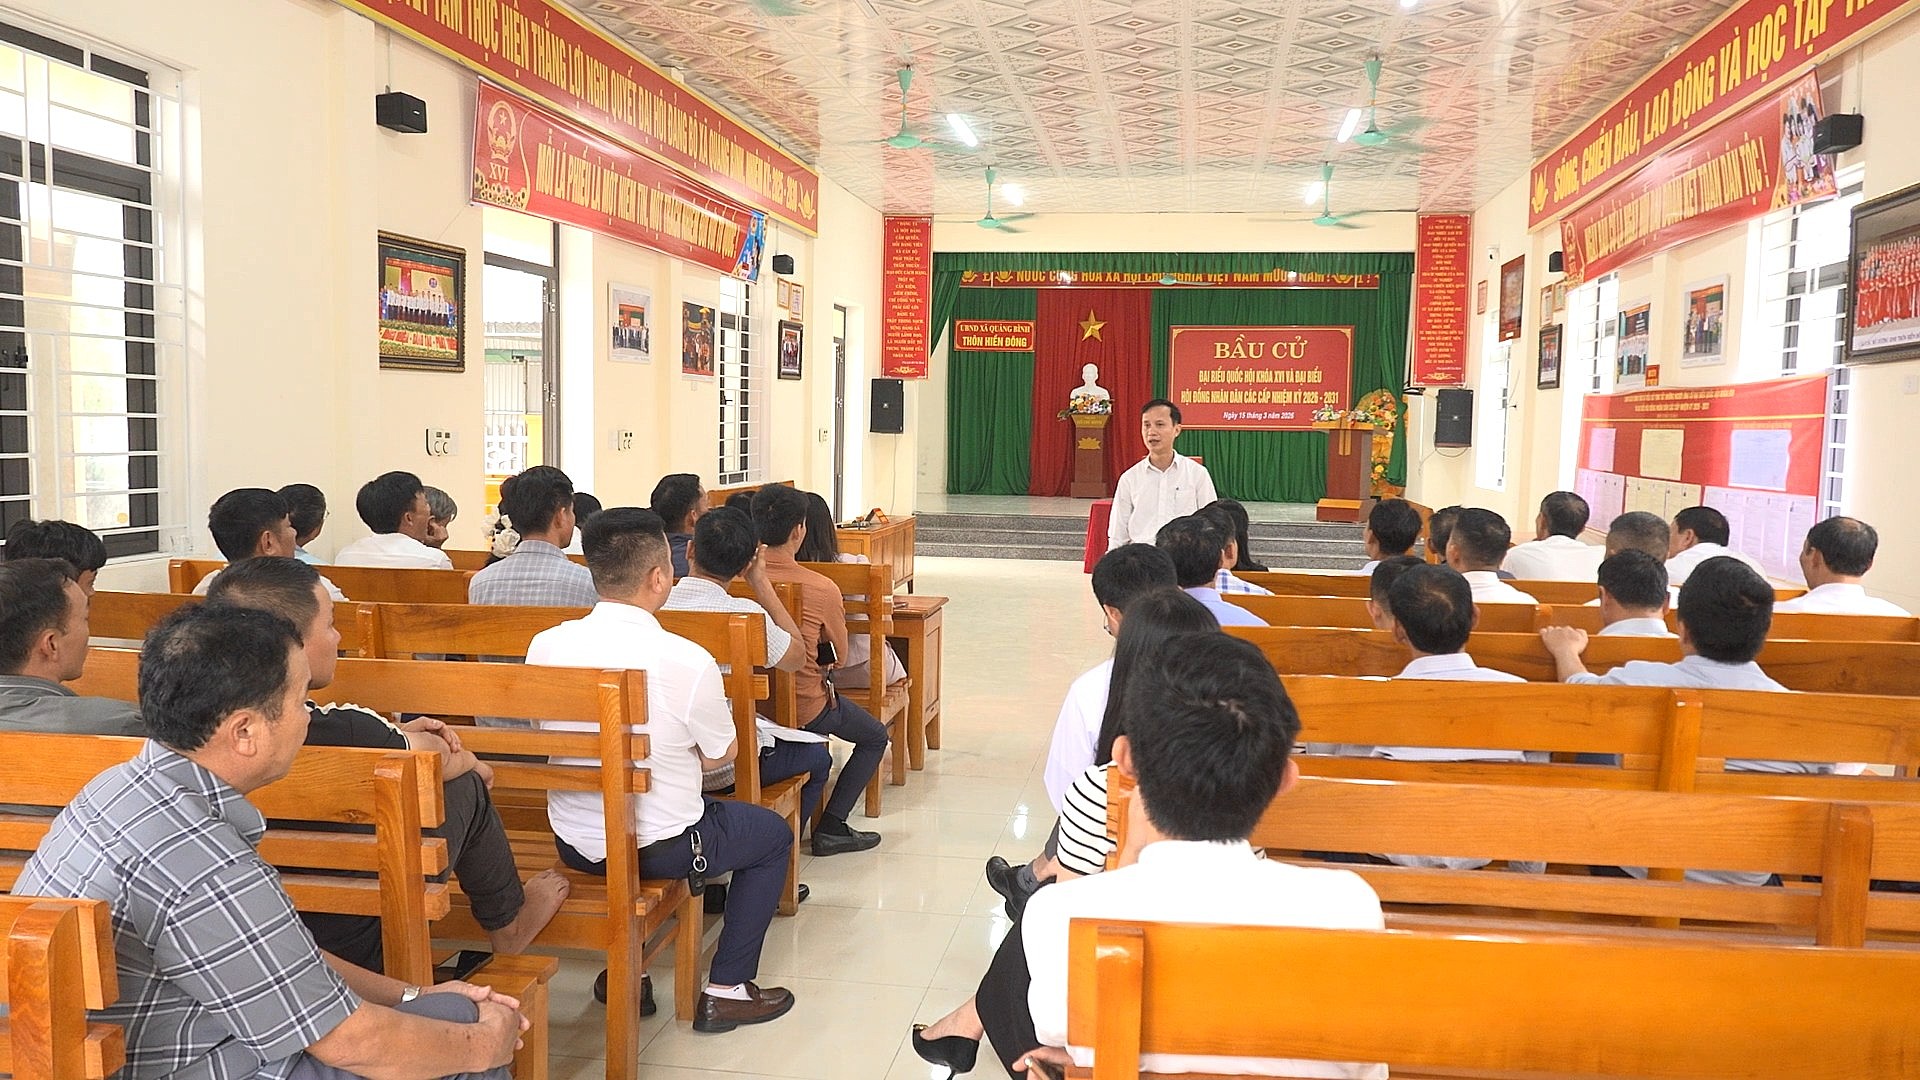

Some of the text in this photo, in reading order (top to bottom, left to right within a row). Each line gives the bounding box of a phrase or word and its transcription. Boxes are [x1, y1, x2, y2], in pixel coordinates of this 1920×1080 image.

[501, 1, 529, 78] HIỆN
[531, 10, 567, 91] THẮNG
[568, 44, 584, 109] LỢI
[586, 54, 609, 124] NGHỊ
[610, 65, 637, 127] QUYẾT
[653, 89, 666, 152] HỘI
[667, 92, 688, 154] ĐẢNG
[1581, 120, 1613, 186] CHIẾN
[1613, 100, 1640, 165] ĐẤU,
[1643, 88, 1670, 145] LAO
[1672, 61, 1715, 129] ĐỘNG
[1719, 26, 1741, 96] VÀ
[1745, 4, 1788, 82] HỌC
[489, 161, 509, 183] XVI
[554, 142, 567, 200] LÁ
[567, 145, 591, 208] PHIẾU
[591, 156, 601, 212] LÀ
[1720, 141, 1743, 204] DÂN
[1738, 131, 1762, 206] TỘC
[960, 324, 979, 332] UBND
[1013, 324, 1031, 333] BÌNH
[962, 334, 983, 347] THÔN
[1213, 333, 1308, 359] BẦU CỬ
[1199, 365, 1322, 385] ĐẠI BIỂU QUỐC HỘI KHÓA XVI VÀ ĐẠI BIỂU
[1181, 388, 1192, 406] HỘI
[1193, 386, 1210, 403] ĐỒNG
[1211, 388, 1229, 403] NHÂN
[1229, 388, 1243, 403] DÂN
[1244, 388, 1257, 403] CÁC
[1257, 386, 1271, 403] CẤP
[1271, 388, 1292, 406] NHIỆM
[1303, 391, 1319, 404] 2026
[1323, 391, 1339, 404] 2031
[1223, 411, 1238, 420] Ngày
[1246, 411, 1263, 420] tháng
[1267, 411, 1280, 419] năm
